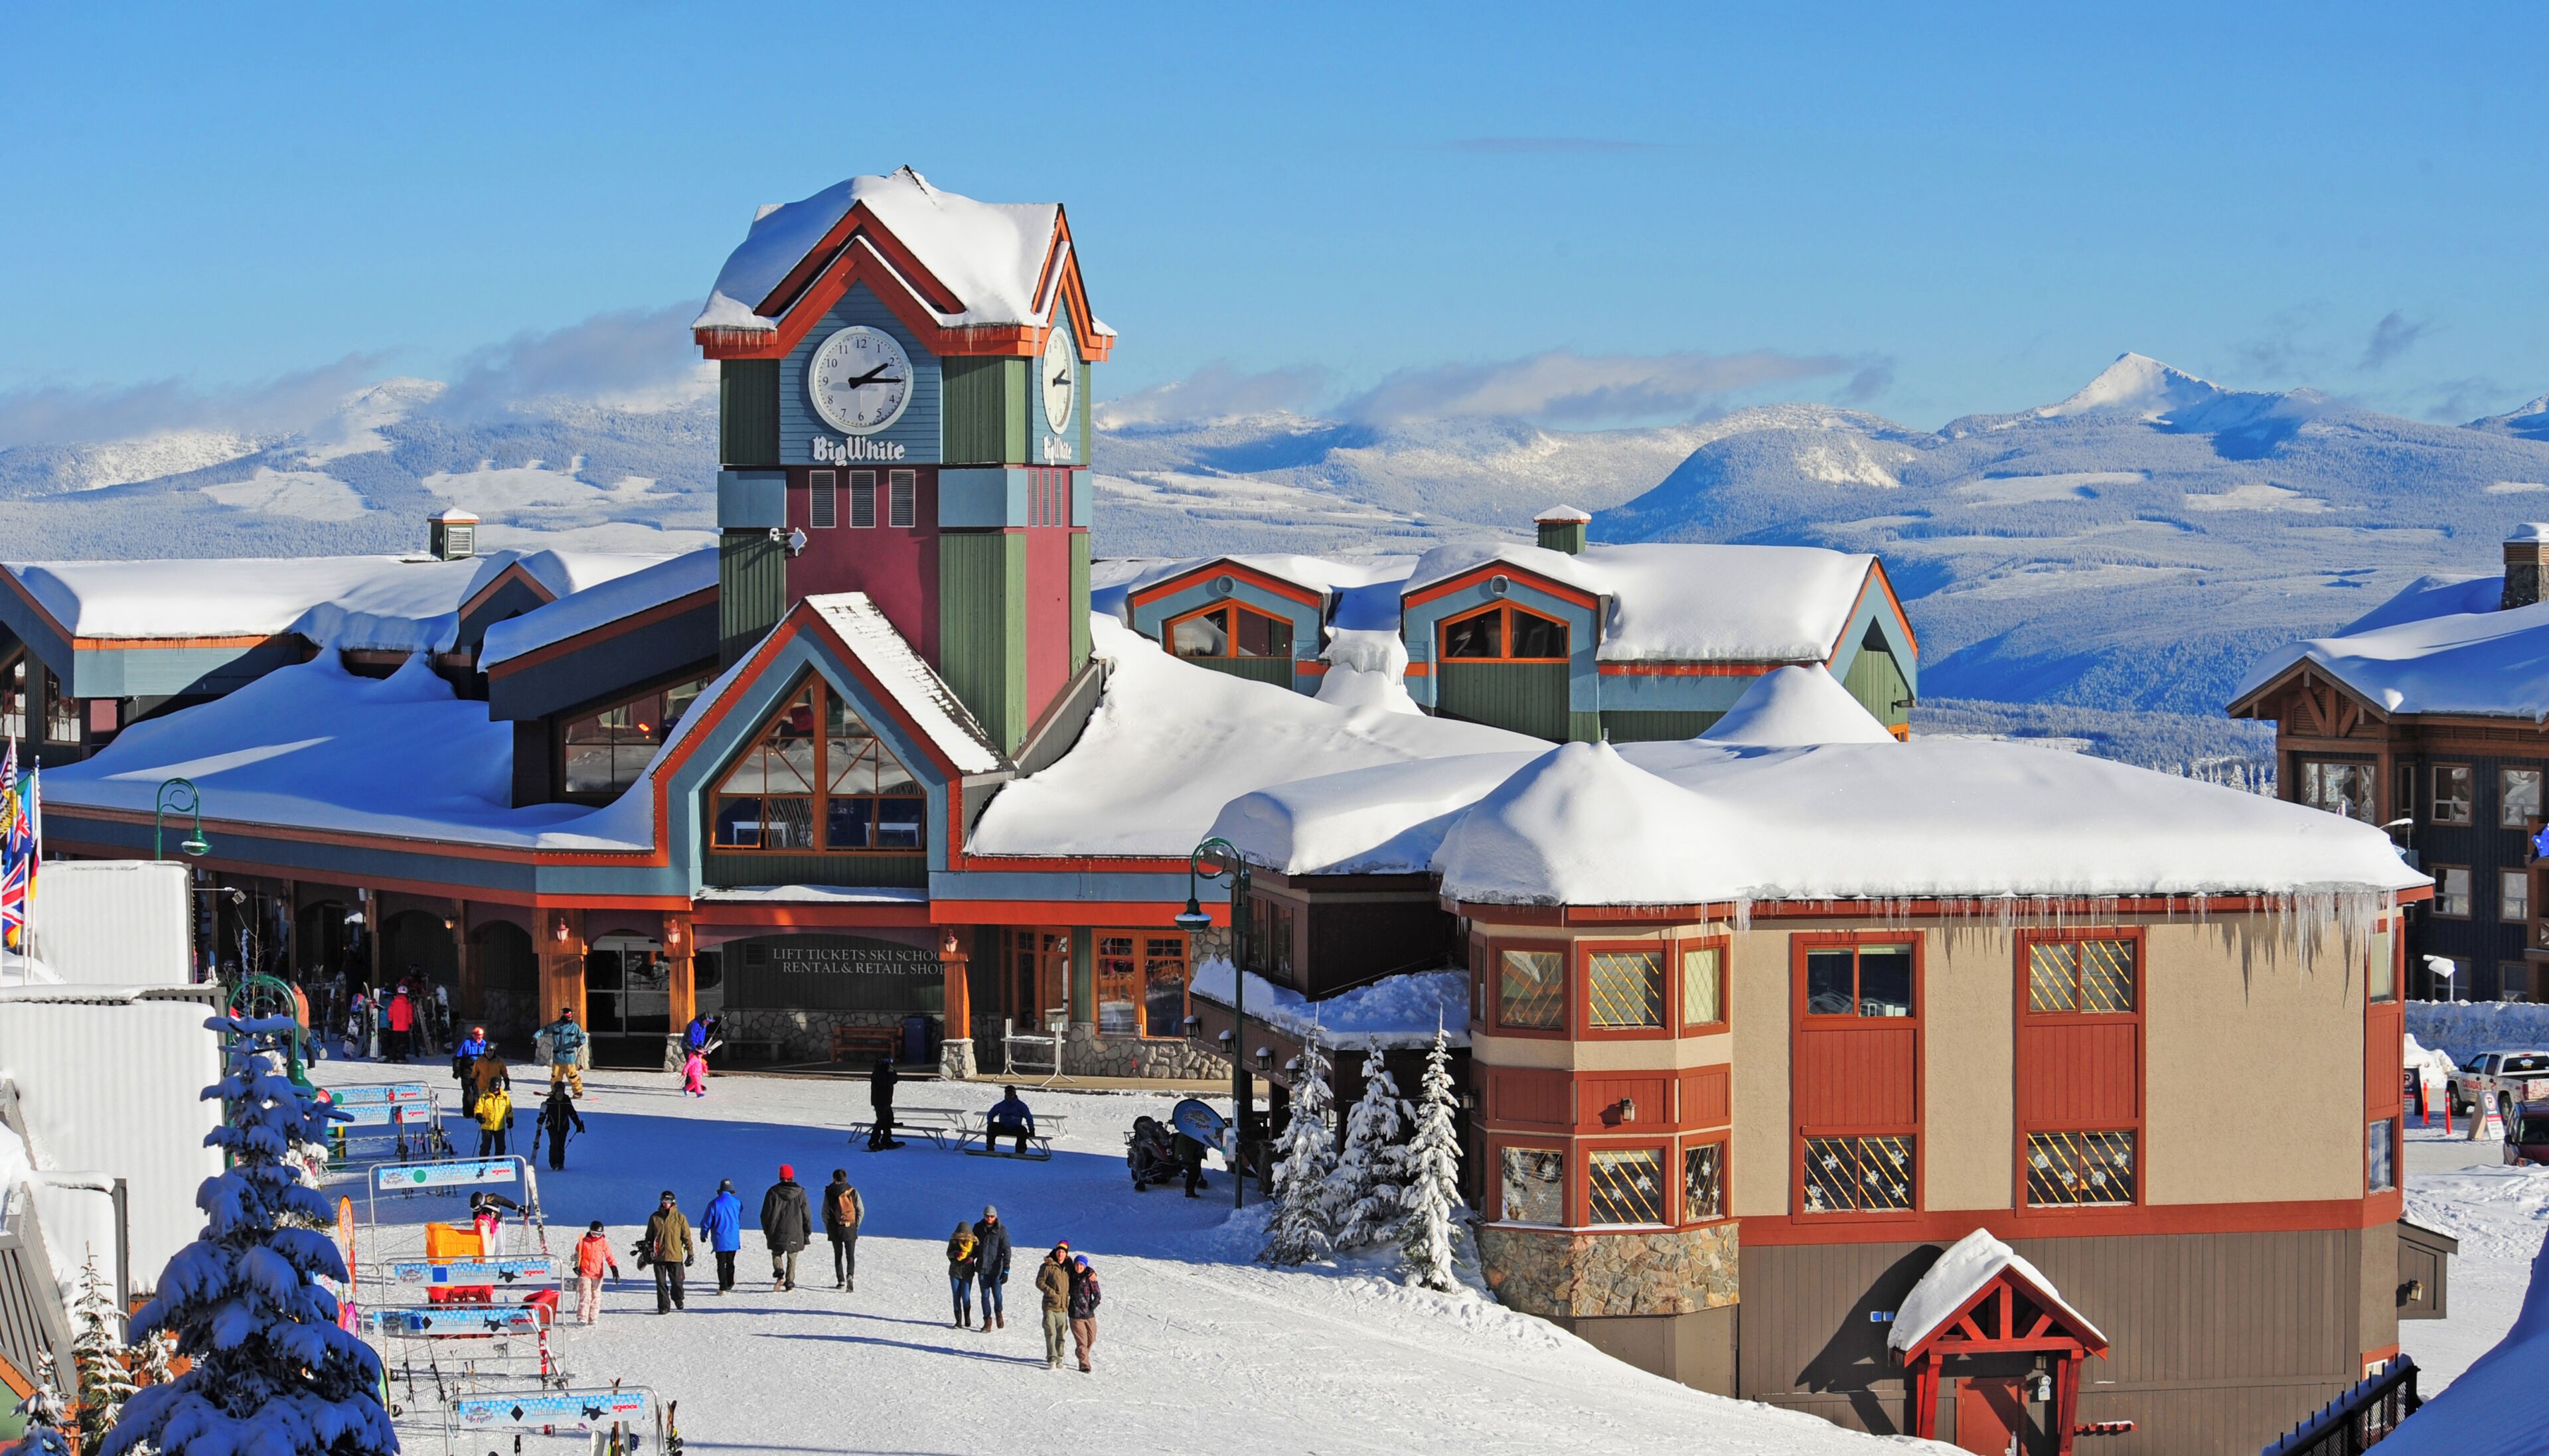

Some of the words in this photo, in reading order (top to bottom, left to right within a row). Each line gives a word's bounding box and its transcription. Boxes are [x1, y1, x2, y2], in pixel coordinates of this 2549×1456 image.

[856, 338, 867, 348] 12
[839, 344, 848, 354] 11
[877, 344, 880, 353] 1
[826, 358, 838, 368] 10
[889, 357, 895, 366] 2
[822, 376, 828, 386] 9
[828, 395, 833, 404] 8
[889, 394, 895, 403] 4
[840, 408, 846, 417] 7
[858, 411, 864, 421] 6
[877, 408, 882, 417] 5
[773, 948, 803, 960] LIFT
[806, 949, 866, 961] TICKETS
[870, 950, 892, 961] SKI
[855, 963, 905, 974] RETAIL
